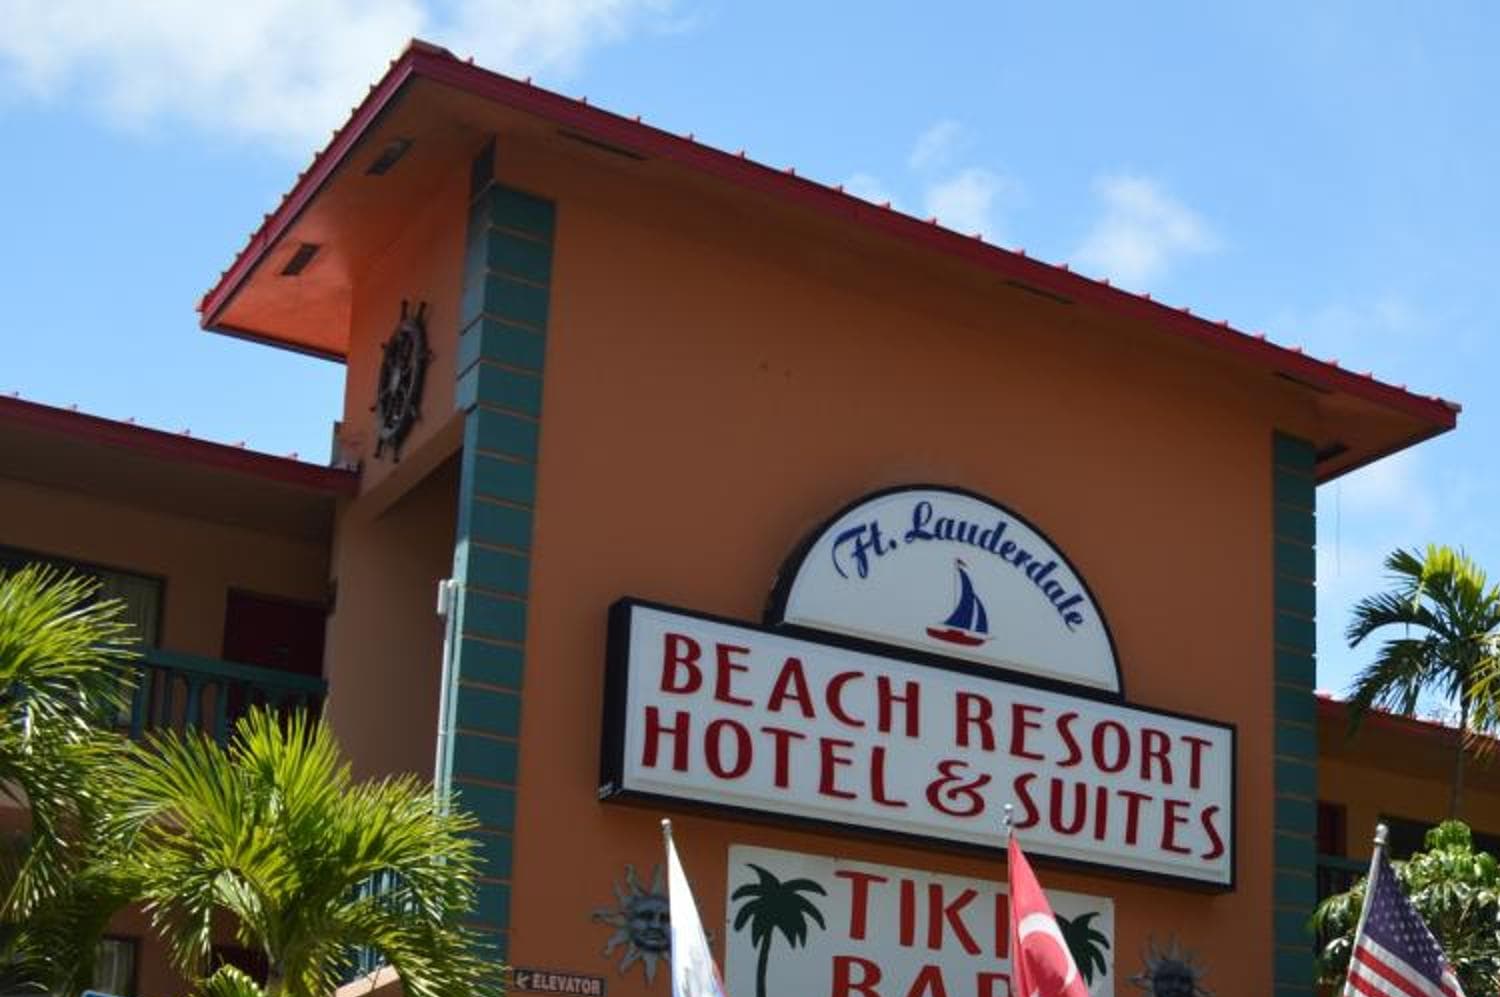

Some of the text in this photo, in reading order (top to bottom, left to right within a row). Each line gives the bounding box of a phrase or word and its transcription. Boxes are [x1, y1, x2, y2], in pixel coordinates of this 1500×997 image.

[832, 500, 1084, 633] Ft. Lauderdale
[660, 632, 1213, 790] BEACH RESORT
[640, 705, 1225, 861] HOTEL & SUITES
[834, 869, 1011, 960] TIKI
[531, 973, 601, 995] ELEVATOR
